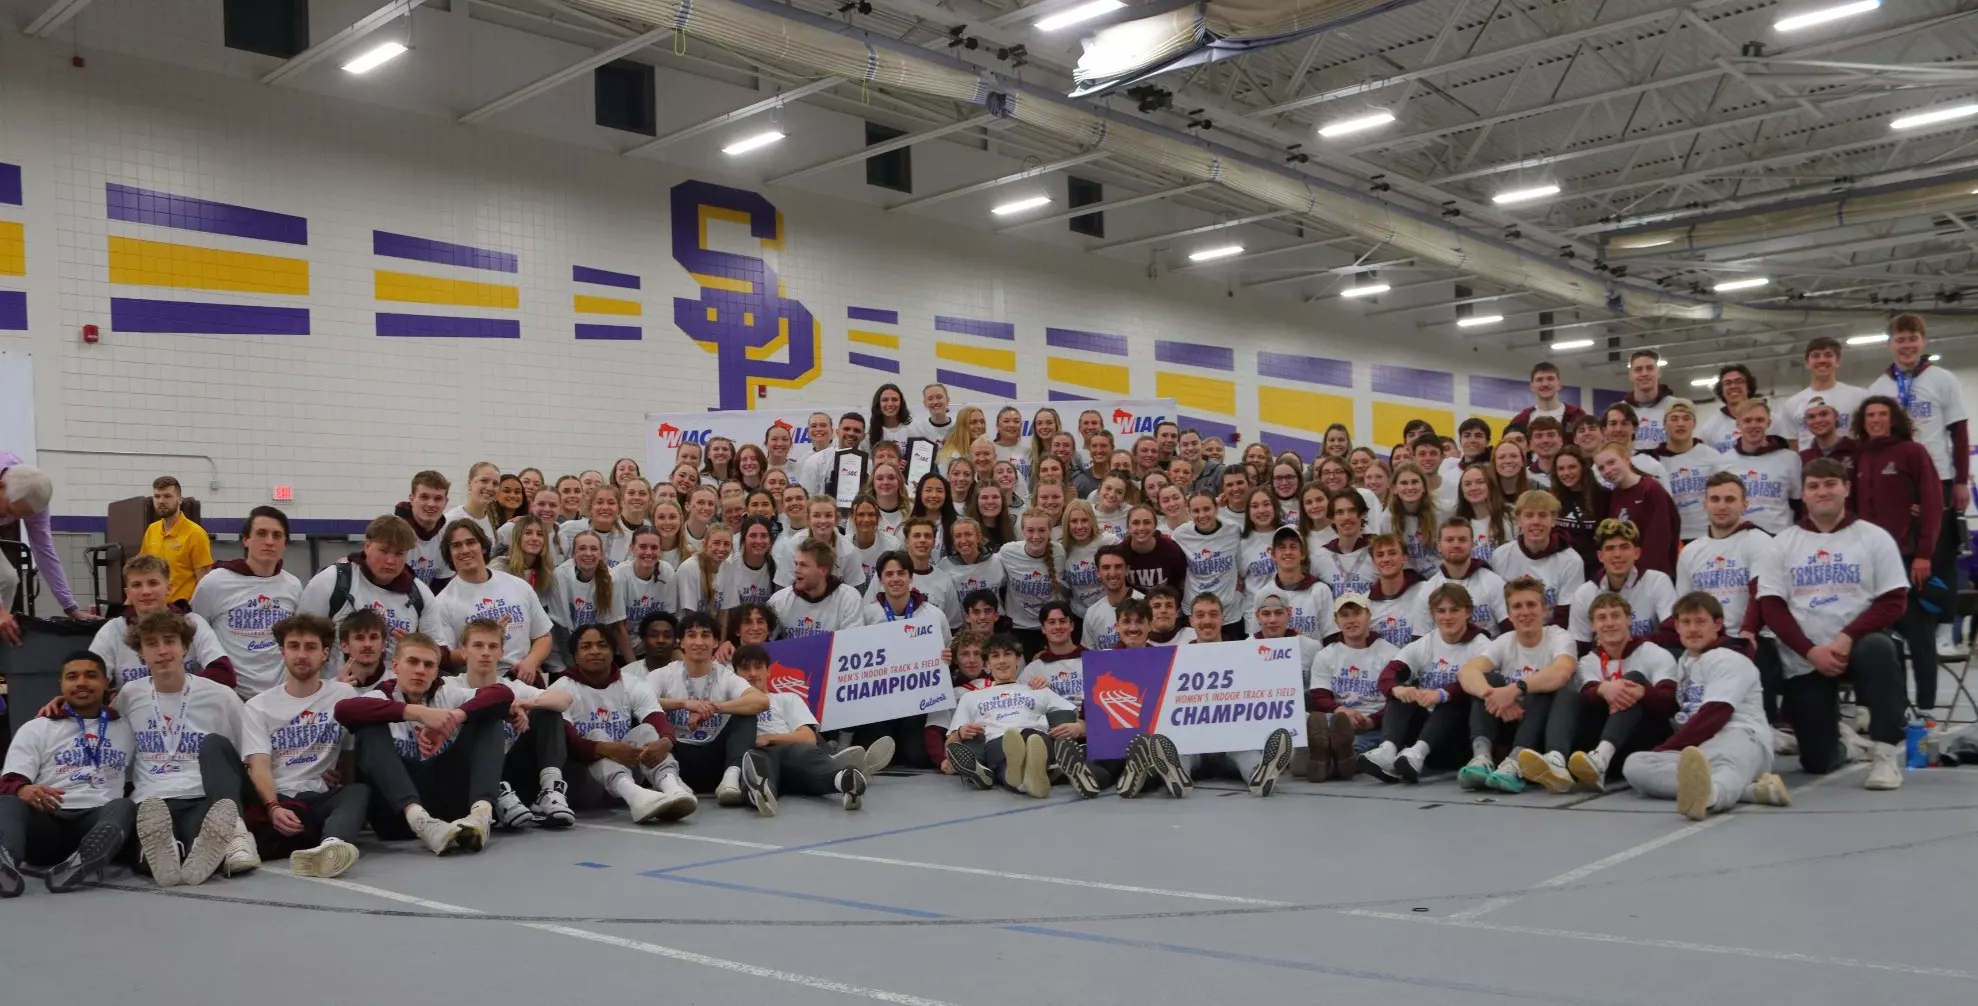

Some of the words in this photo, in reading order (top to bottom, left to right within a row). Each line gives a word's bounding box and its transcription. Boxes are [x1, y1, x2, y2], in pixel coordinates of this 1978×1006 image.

[1113, 409, 1165, 434] WIAC
[660, 424, 712, 448] WIAC
[248, 600, 257, 608] 24
[496, 598, 505, 607] 25
[838, 648, 886, 673] 2025
[837, 672, 859, 683] MEN'S
[861, 667, 888, 679] INDOOR
[890, 663, 911, 674] TRACK
[913, 662, 919, 670] &
[921, 658, 940, 669] FIELD
[836, 668, 941, 703] CHAMPIONS
[1177, 670, 1234, 691] 2025
[919, 693, 948, 711] Culver's
[1175, 693, 1210, 704] WOMEN'S
[1212, 691, 1240, 701] INDOOR
[1243, 689, 1266, 699] TRACK
[1267, 689, 1273, 697] &
[1276, 687, 1296, 698] FIELD
[318, 713, 328, 722] 25
[611, 711, 619, 720] 25
[1170, 700, 1295, 727] CHAMPIONS
[148, 719, 157, 730] 24
